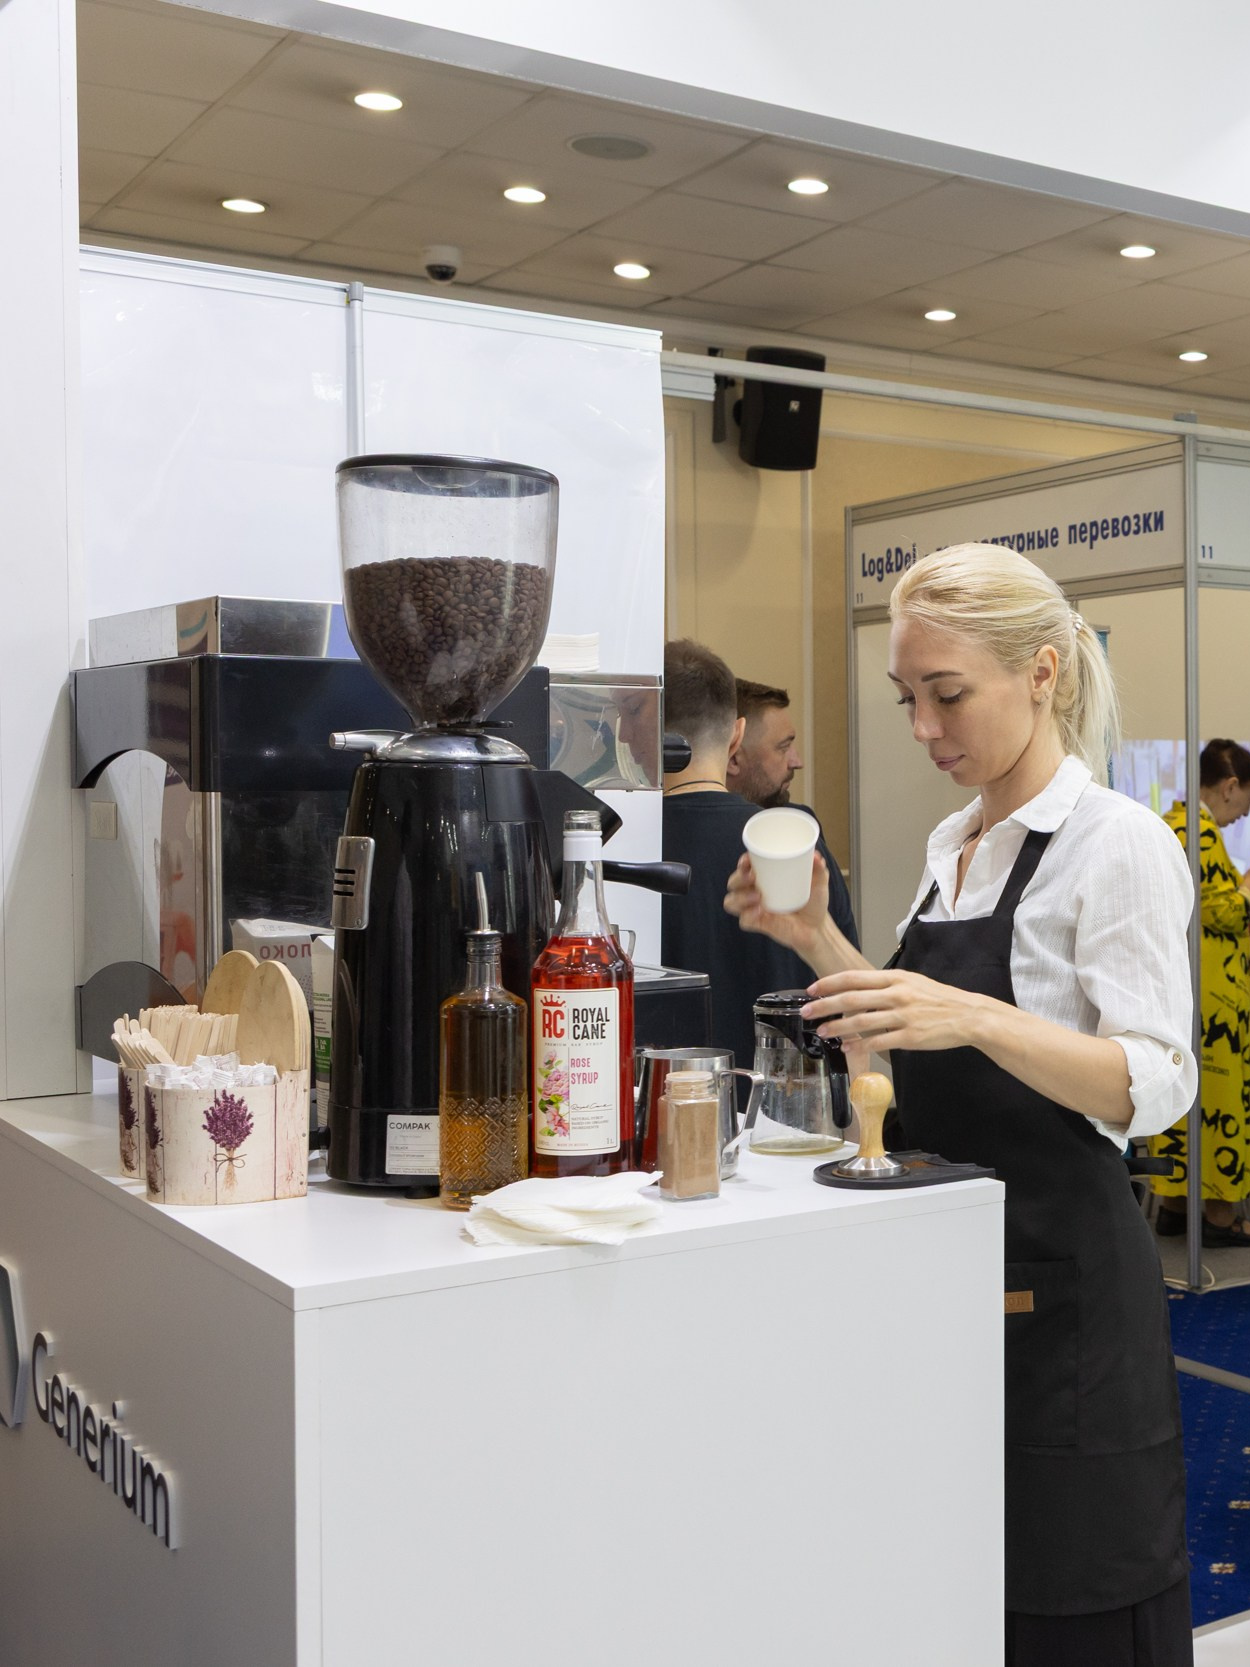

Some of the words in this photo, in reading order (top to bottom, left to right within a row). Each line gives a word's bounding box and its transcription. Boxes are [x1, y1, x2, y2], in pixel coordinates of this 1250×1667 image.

[1068, 510, 1165, 550] перевозки
[1201, 544, 1213, 560] 11
[542, 1008, 566, 1039] RC
[572, 1006, 611, 1024] ROYAL
[572, 1023, 607, 1041] CANE
[570, 1057, 591, 1068] ROSE
[570, 1071, 599, 1085] SYRUP
[389, 1122, 431, 1130] COMPAK
[32, 1331, 178, 1550] Generium
